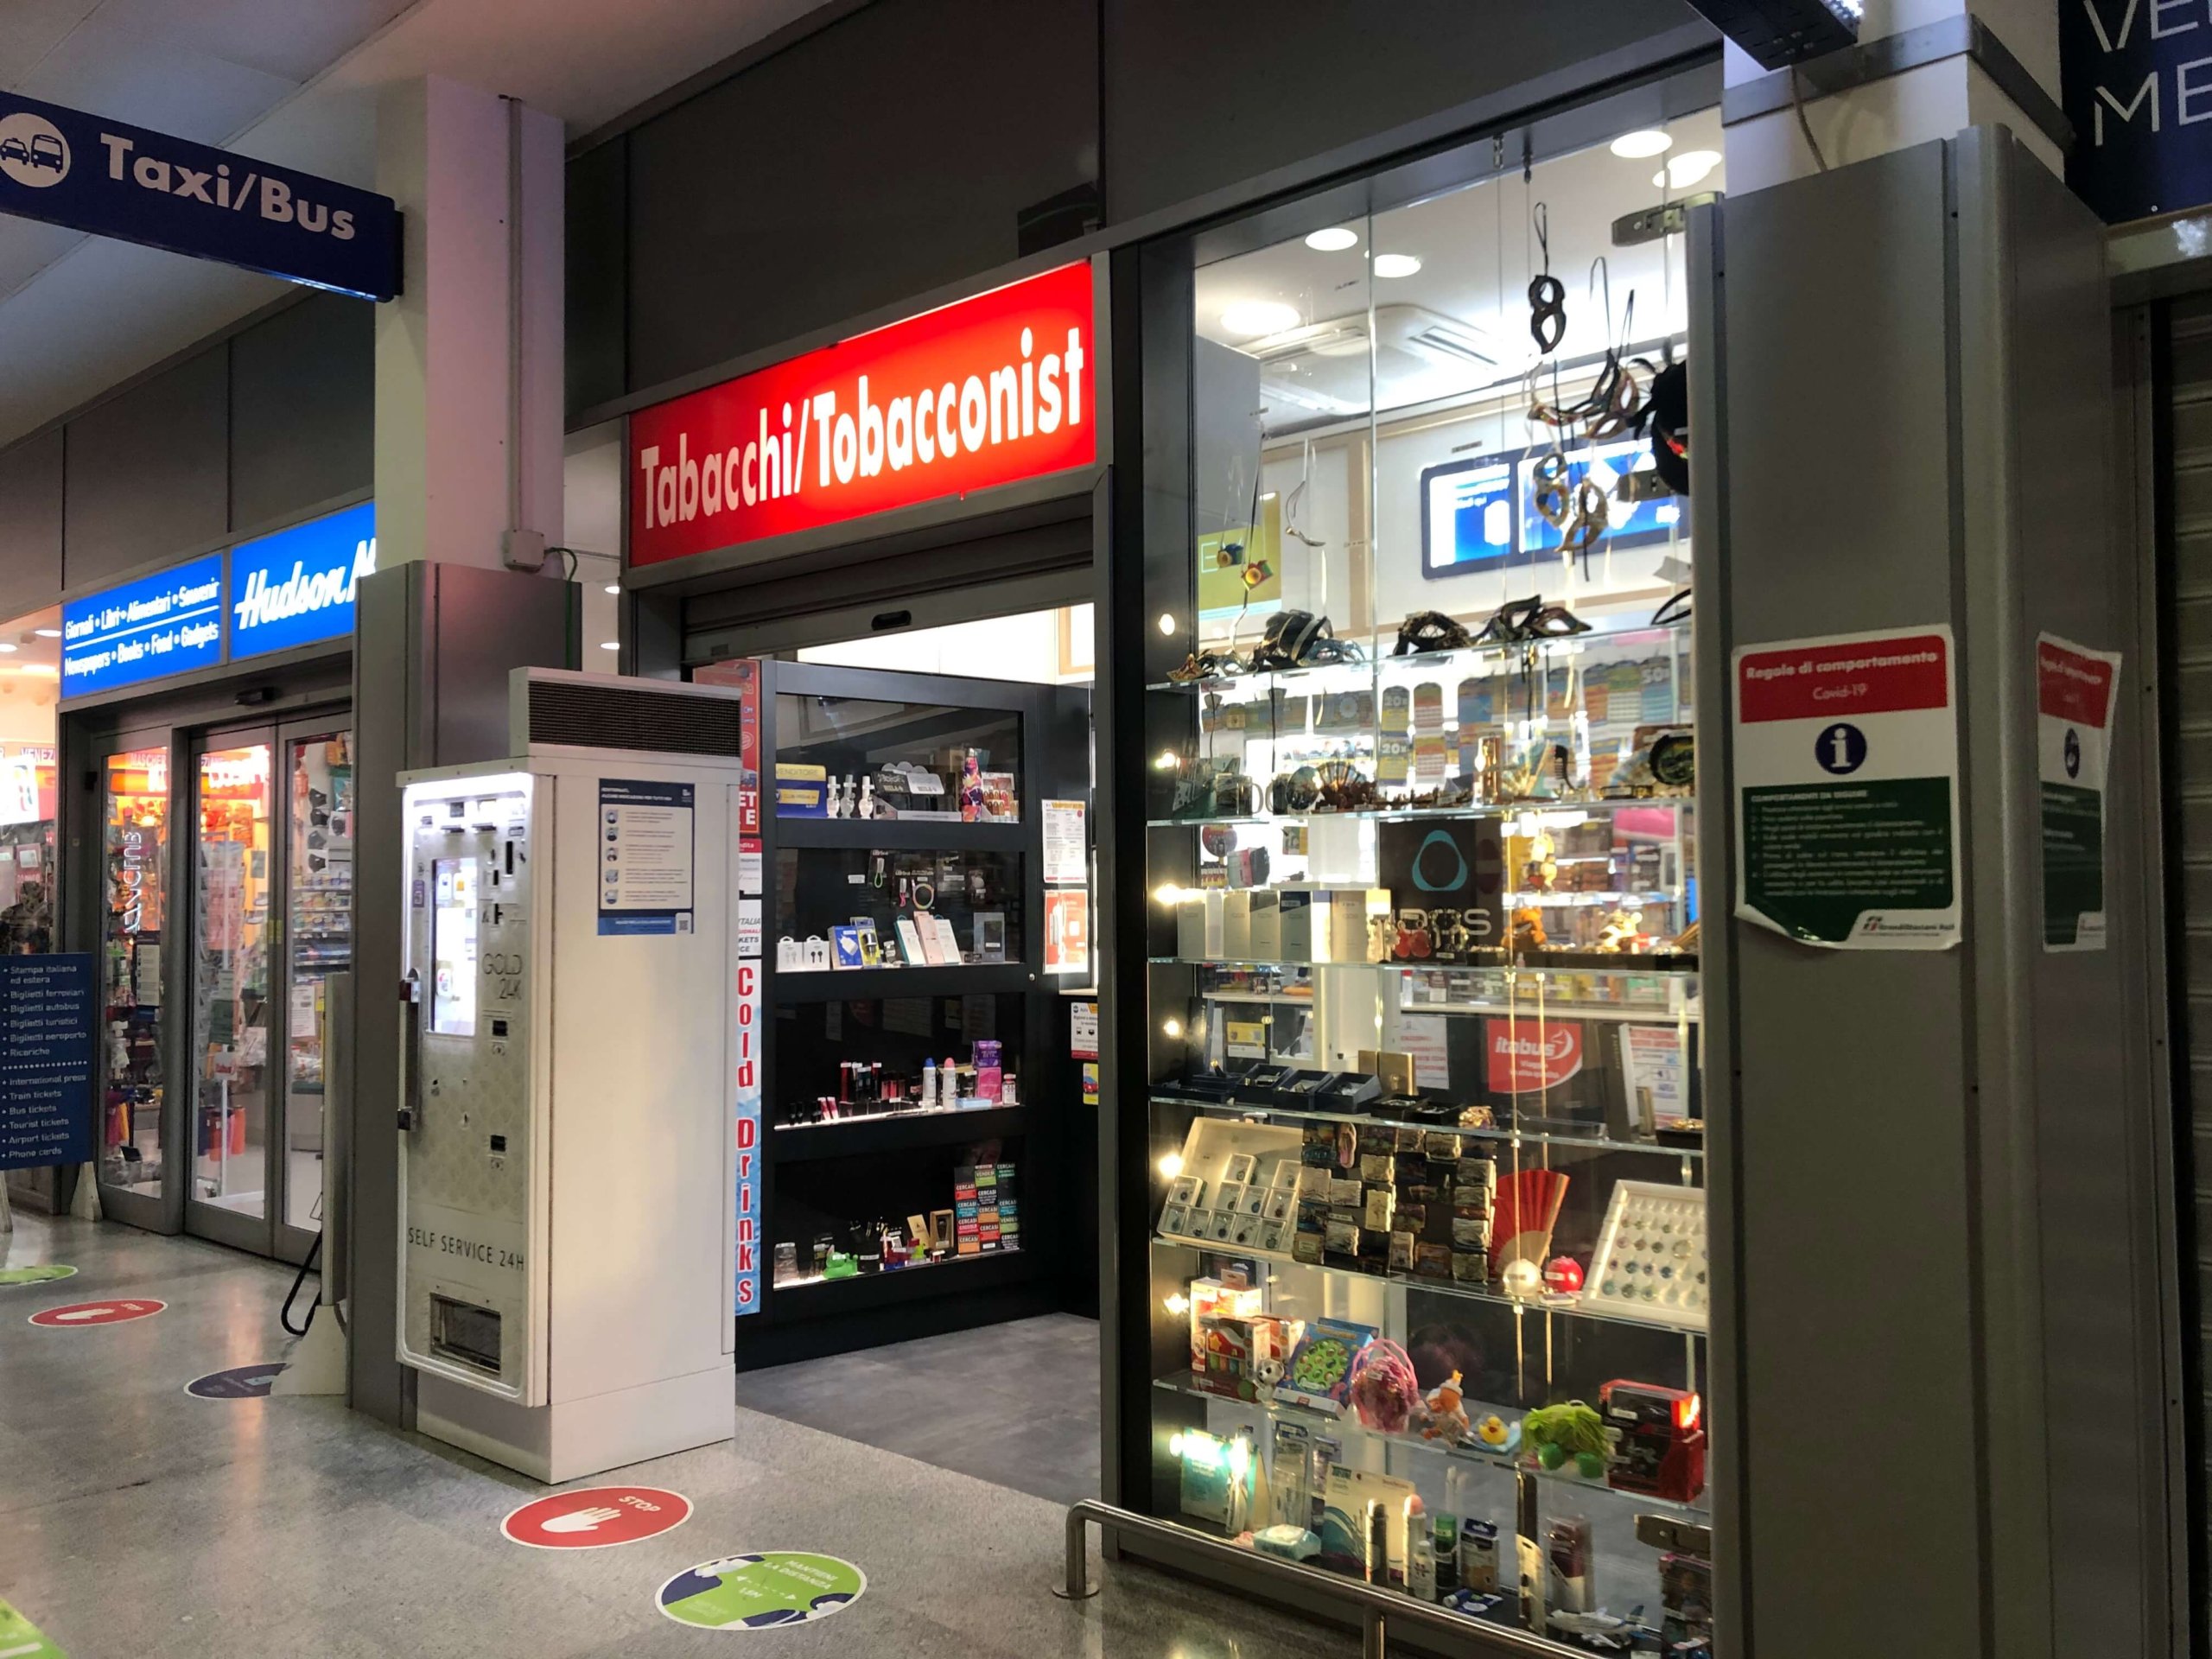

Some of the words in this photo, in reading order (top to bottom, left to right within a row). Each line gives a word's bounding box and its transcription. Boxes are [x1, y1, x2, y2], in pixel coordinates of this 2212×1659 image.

[100, 132, 355, 240] Taxi/Bus
[641, 327, 1084, 529] Tabacchi/Tobacconist
[234, 561, 346, 630] Hudson
[118, 639, 143, 664] Books
[151, 630, 173, 655] Food
[181, 621, 219, 649] Gadgets
[1745, 664, 1796, 680] Regole
[1798, 660, 1813, 675] di
[1816, 651, 1939, 673] comportamento
[1812, 683, 1869, 701] Covid-19
[10, 965, 44, 976] Stampa
[46, 964, 77, 974] italiana
[23, 976, 50, 984] estera
[10, 990, 44, 1001] Biglietti
[10, 1004, 43, 1014] Biglietti
[46, 1002, 79, 1012] autobus
[10, 1020, 43, 1030] Biglietti
[46, 1017, 78, 1027] turistici
[737, 966, 754, 1088] Cold
[10, 1034, 43, 1044] Biglietti
[10, 1047, 50, 1057] Ricariche
[1495, 1036, 1556, 1056] itabus
[10, 1076, 62, 1086] International
[64, 1074, 86, 1084] press
[34, 1090, 62, 1099] tickets
[29, 1104, 57, 1114] tickets
[10, 1121, 39, 1130] Tourist
[41, 1118, 69, 1128] tickets
[9, 1135, 39, 1146] Airport
[41, 1132, 70, 1141] tickets
[9, 1150, 36, 1159] Phone
[39, 1147, 62, 1156] cards
[736, 1118, 756, 1304] Drinks
[408, 1227, 435, 1249] SELF
[441, 1235, 493, 1264] SERVICE
[499, 1249, 524, 1272] 24H
[618, 1495, 662, 1514] STOP
